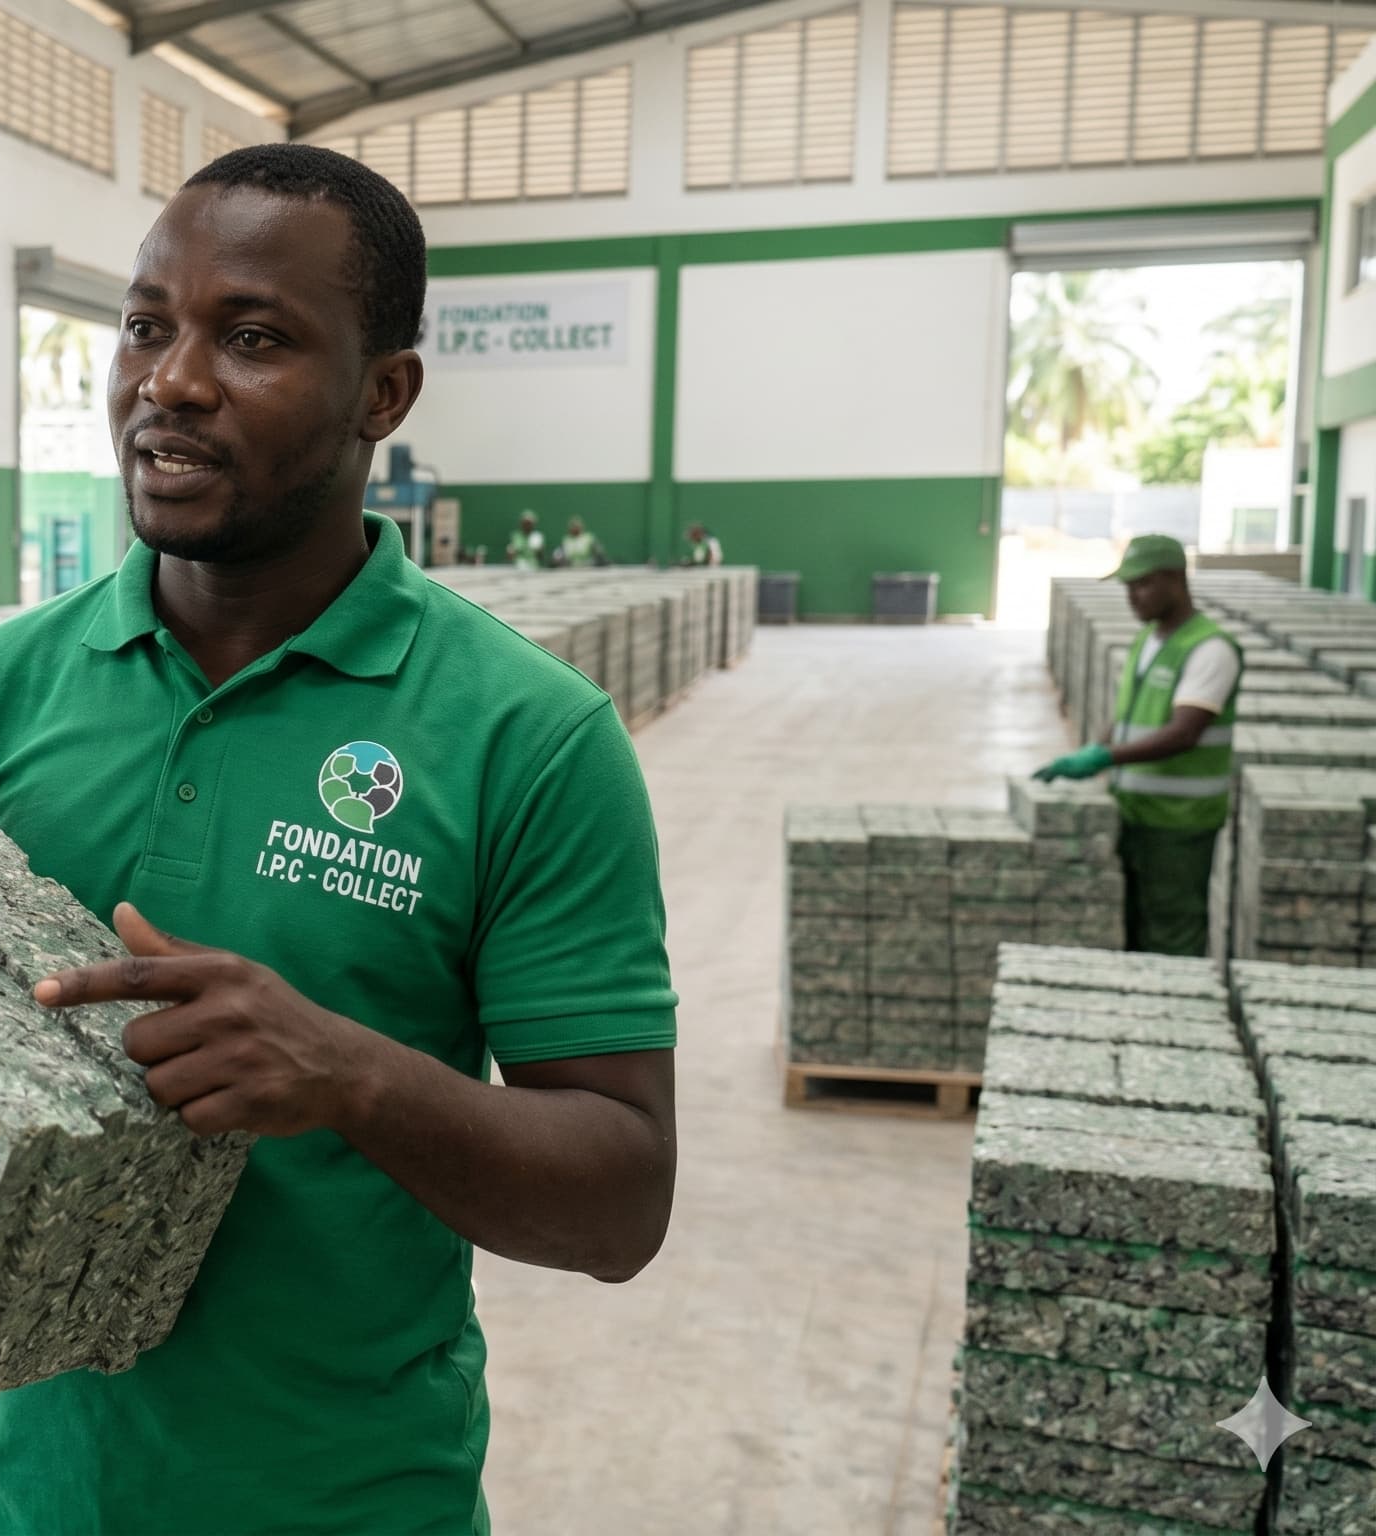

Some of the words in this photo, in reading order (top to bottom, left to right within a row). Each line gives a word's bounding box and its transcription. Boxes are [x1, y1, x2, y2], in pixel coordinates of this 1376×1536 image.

[438, 303, 550, 325] FONDATION
[509, 323, 613, 352] COLLECT
[267, 820, 422, 884] FONDATION
[256, 850, 304, 883] I.P.C
[322, 867, 423, 916] COLLECT
